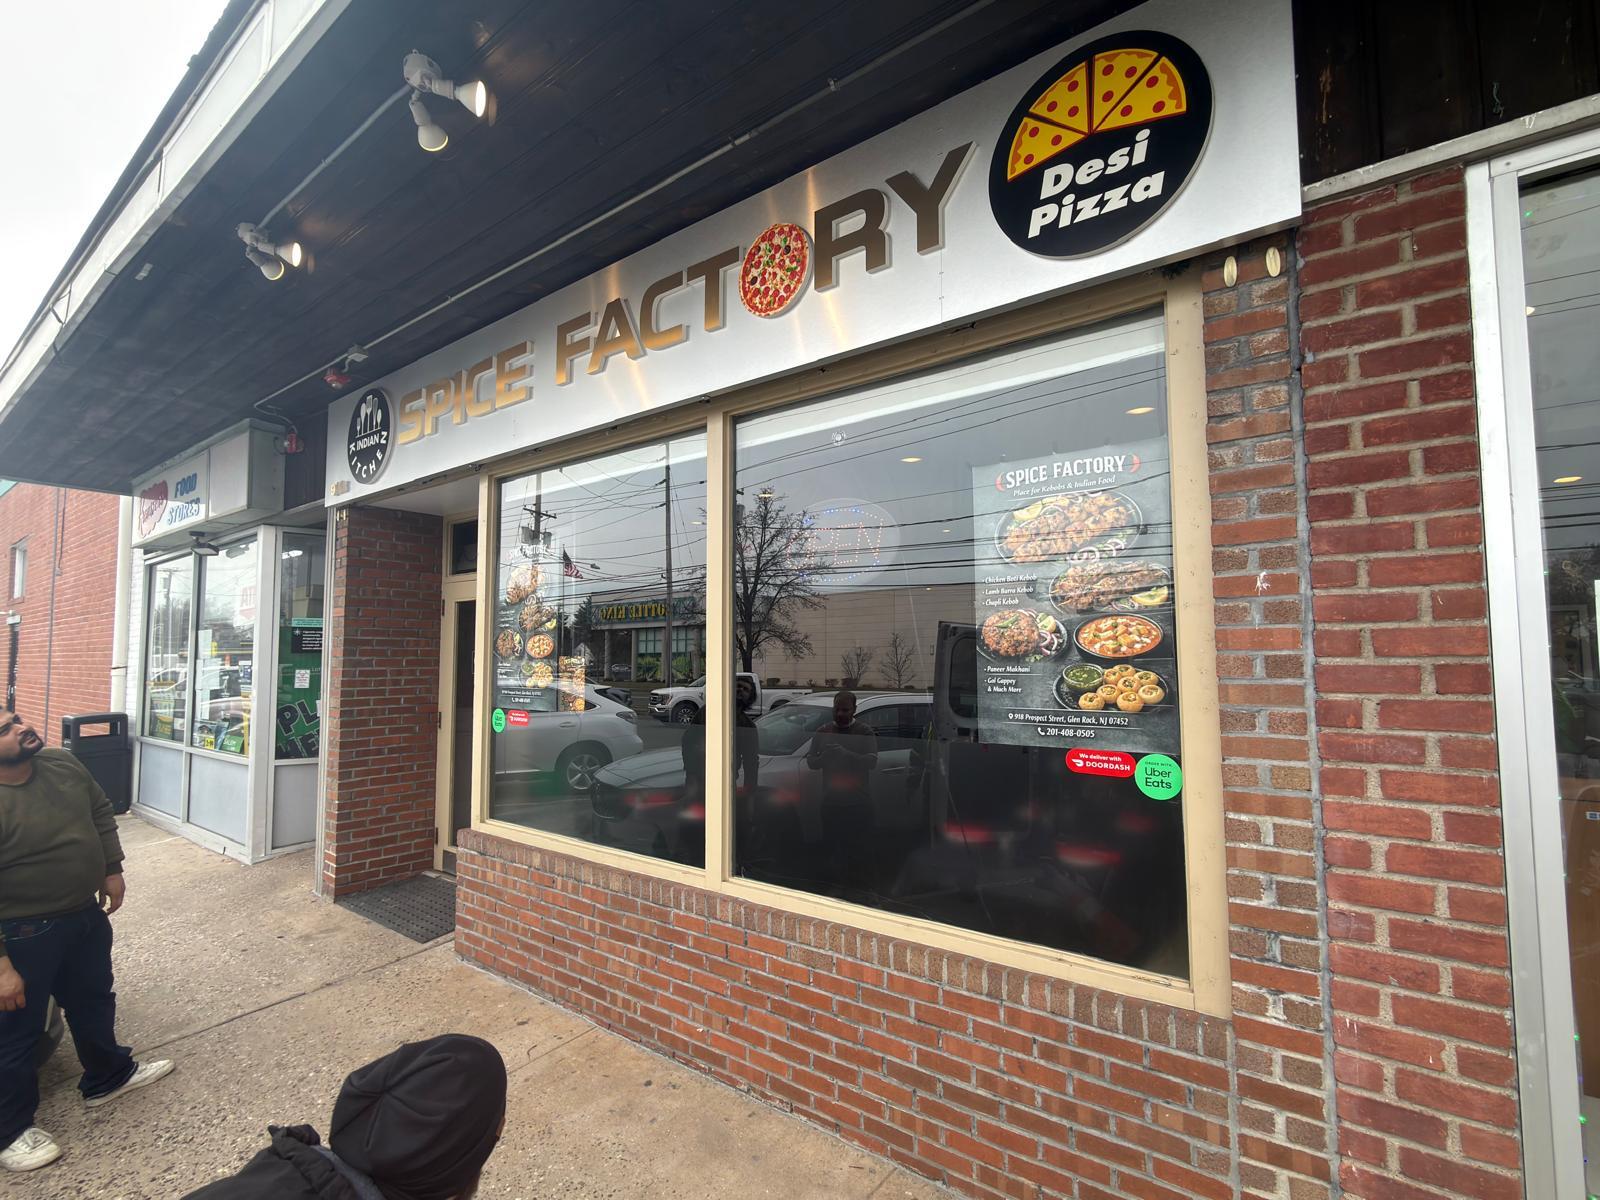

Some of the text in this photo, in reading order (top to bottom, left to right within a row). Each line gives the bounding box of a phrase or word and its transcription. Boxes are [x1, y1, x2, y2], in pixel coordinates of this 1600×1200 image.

[1039, 128, 1151, 200] Desi
[1027, 170, 1166, 239] Pizza
[398, 340, 535, 446] SPICE
[356, 433, 380, 452] INDIAN
[349, 431, 388, 478] KITCHEN
[1005, 455, 1126, 489] SPICE FACTORY
[174, 472, 198, 499] FOOD
[1013, 489, 1030, 497] Place
[1030, 486, 1040, 496] for
[1074, 479, 1097, 488] Indian
[1098, 474, 1117, 485] Food
[168, 496, 201, 526] STORES
[985, 575, 1006, 584] Chicken
[985, 587, 1000, 595] Lamb
[1002, 597, 1019, 605] Kebob
[987, 665, 1031, 673] Paneer Makhani
[1008, 686, 1022, 694] More
[1025, 713, 1047, 722] Prospect
[1048, 714, 1067, 723] Street,
[1067, 715, 1081, 723] Glen
[1082, 716, 1098, 725] Rock,
[1100, 717, 1108, 726] NJ
[1108, 717, 1129, 726] 07452
[1046, 728, 1095, 738] 201-408-0505
[1089, 753, 1109, 761] deliver
[1085, 761, 1131, 771] DOORDASH
[1144, 766, 1172, 778] Uber
[1144, 777, 1173, 790] Eats
